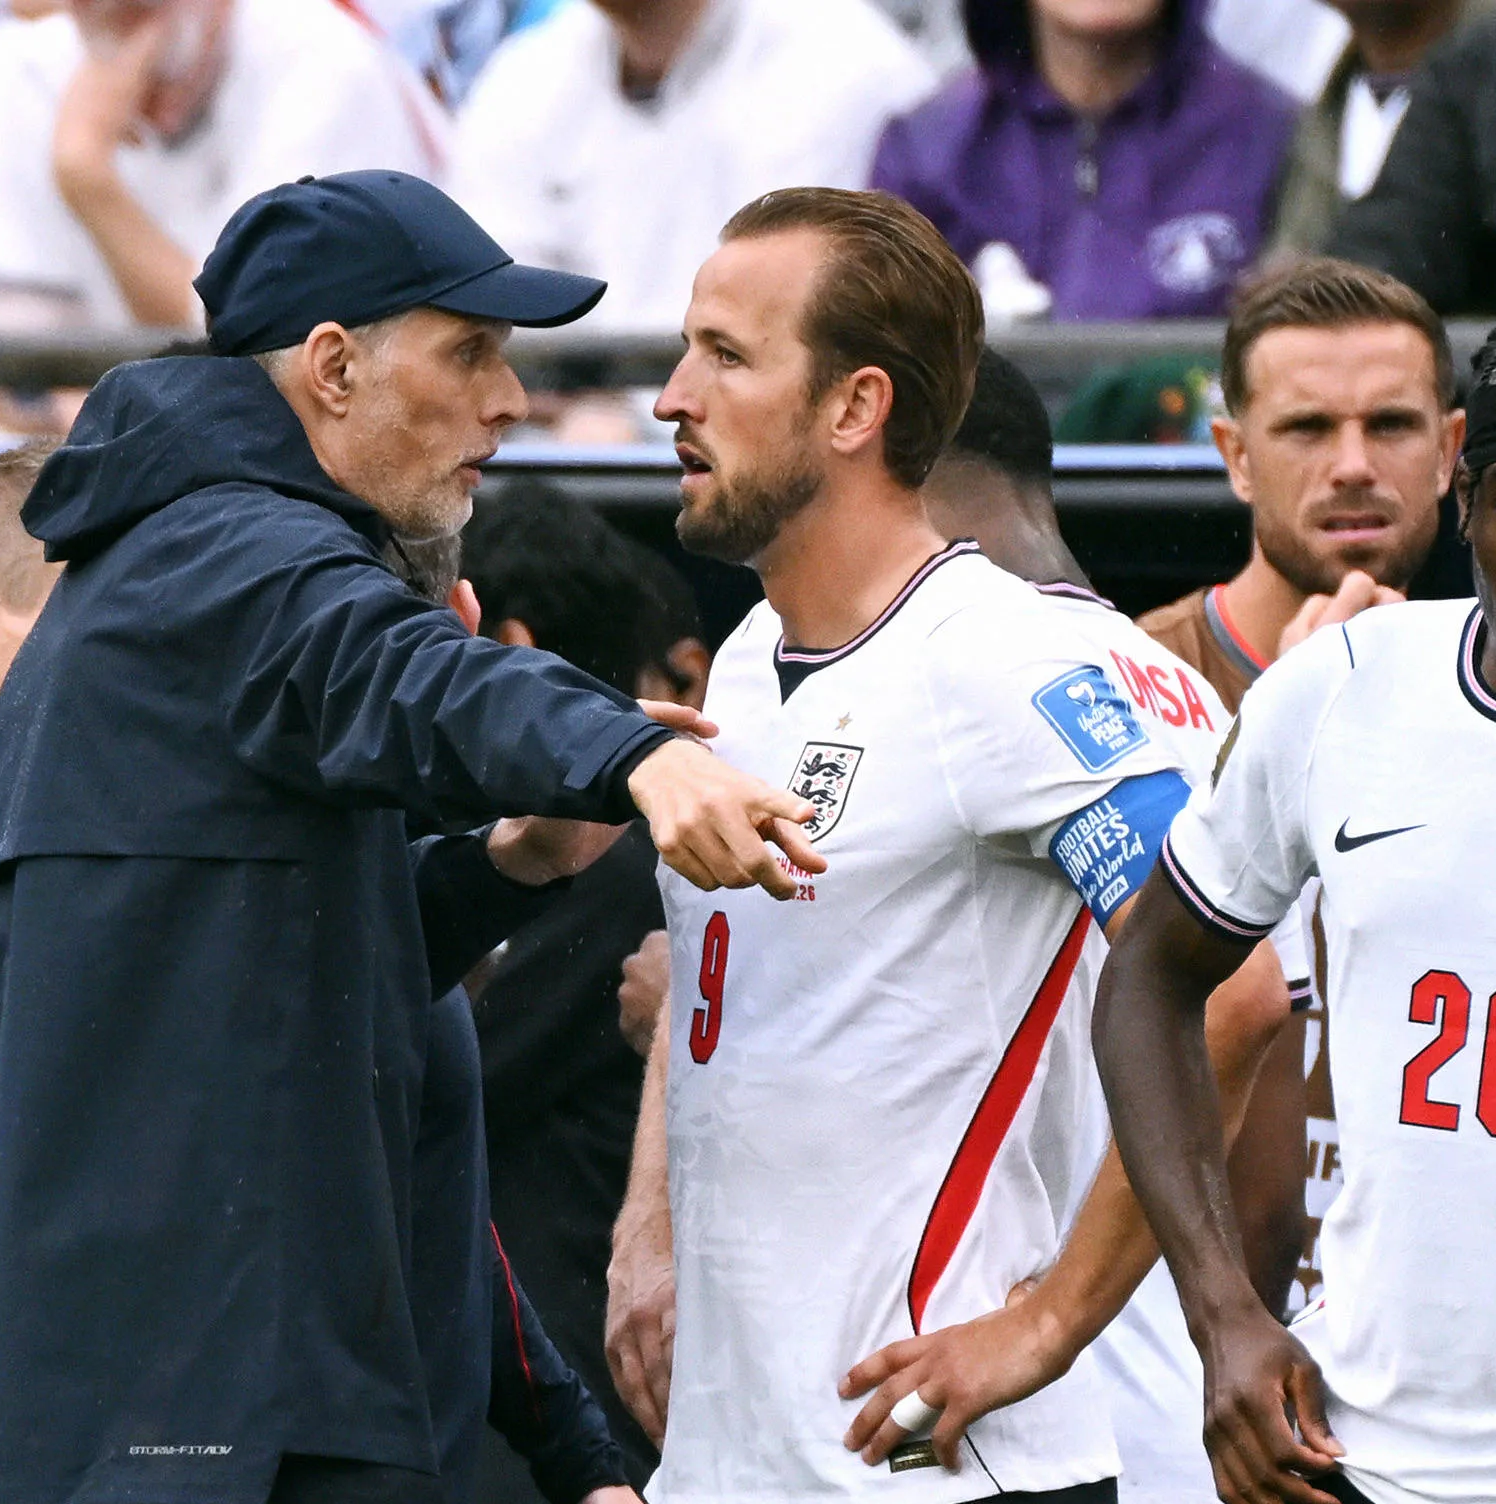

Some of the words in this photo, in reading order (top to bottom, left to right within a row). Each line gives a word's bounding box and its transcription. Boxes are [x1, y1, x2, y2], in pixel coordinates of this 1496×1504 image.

[1056, 799, 1120, 864] FOOTBALL
[1065, 813, 1130, 886] UNITES
[1090, 831, 1146, 888] World
[1101, 880, 1125, 907] FIFA
[689, 910, 730, 1065] 9
